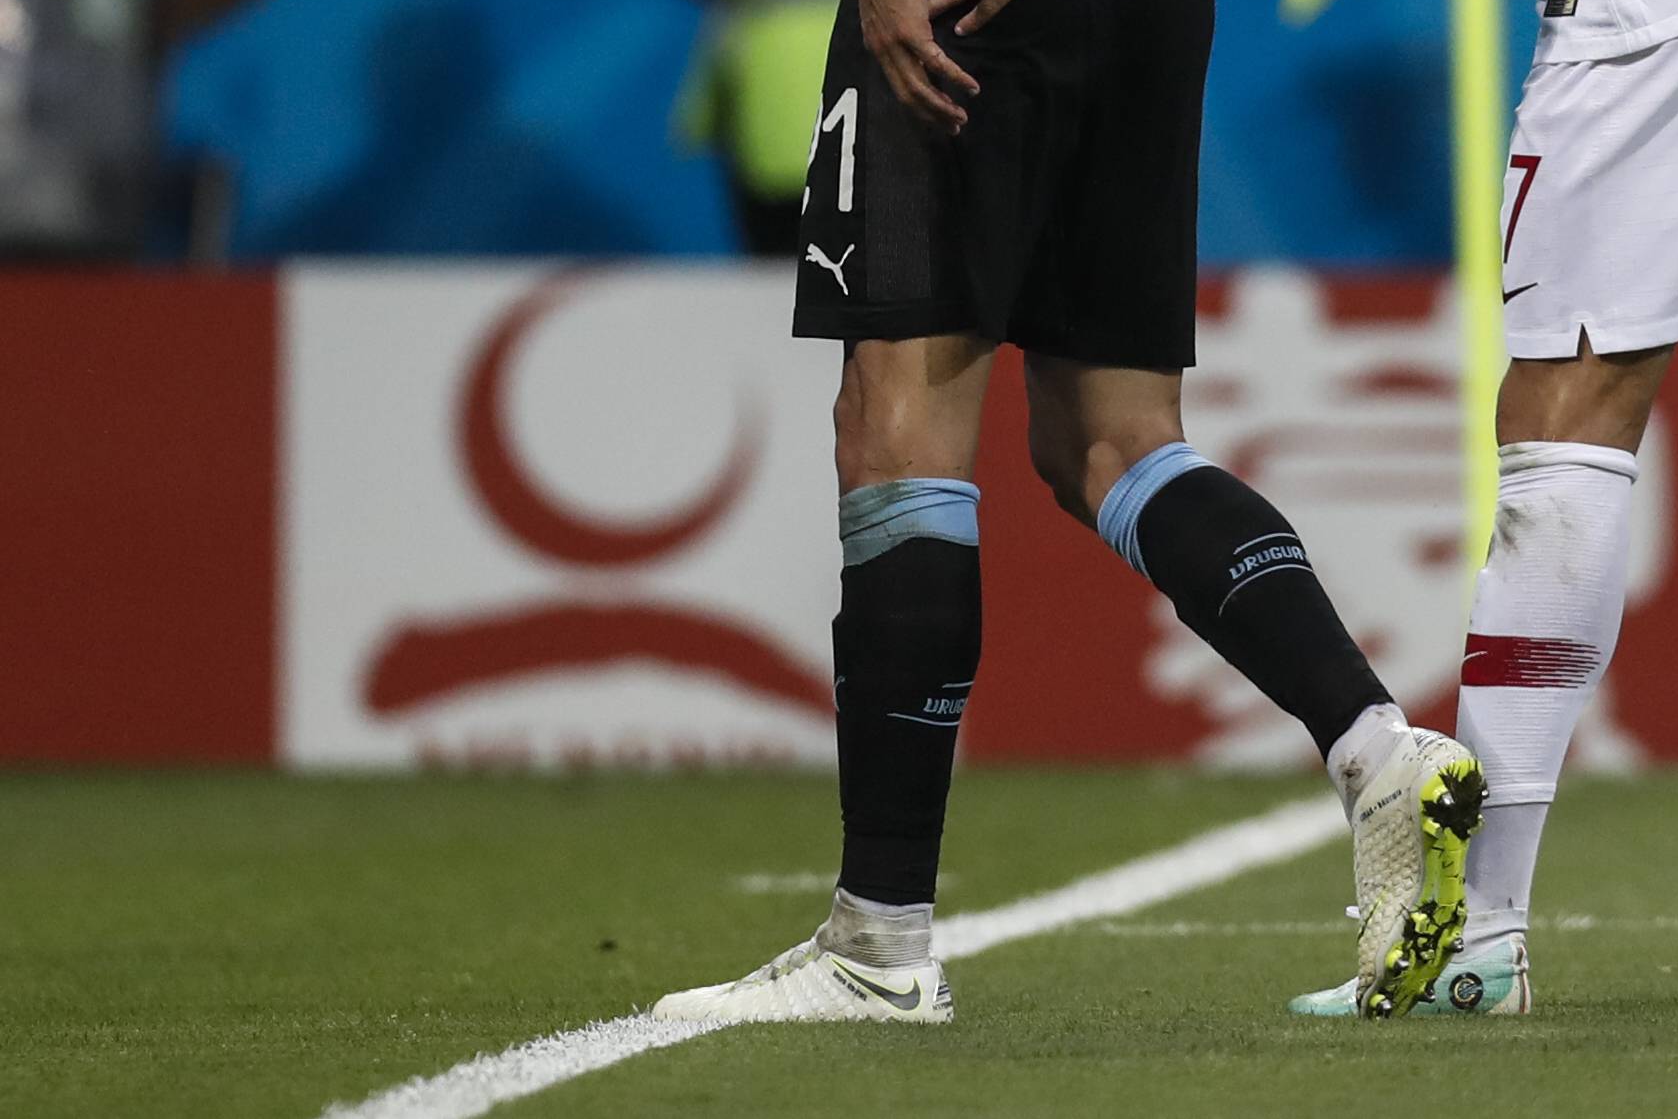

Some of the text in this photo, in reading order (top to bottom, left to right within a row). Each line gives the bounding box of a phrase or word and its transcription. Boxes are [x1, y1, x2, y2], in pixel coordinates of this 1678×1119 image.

[802, 88, 858, 213] 1
[1503, 154, 1542, 264] 7
[1229, 546, 1308, 580] URUGUA
